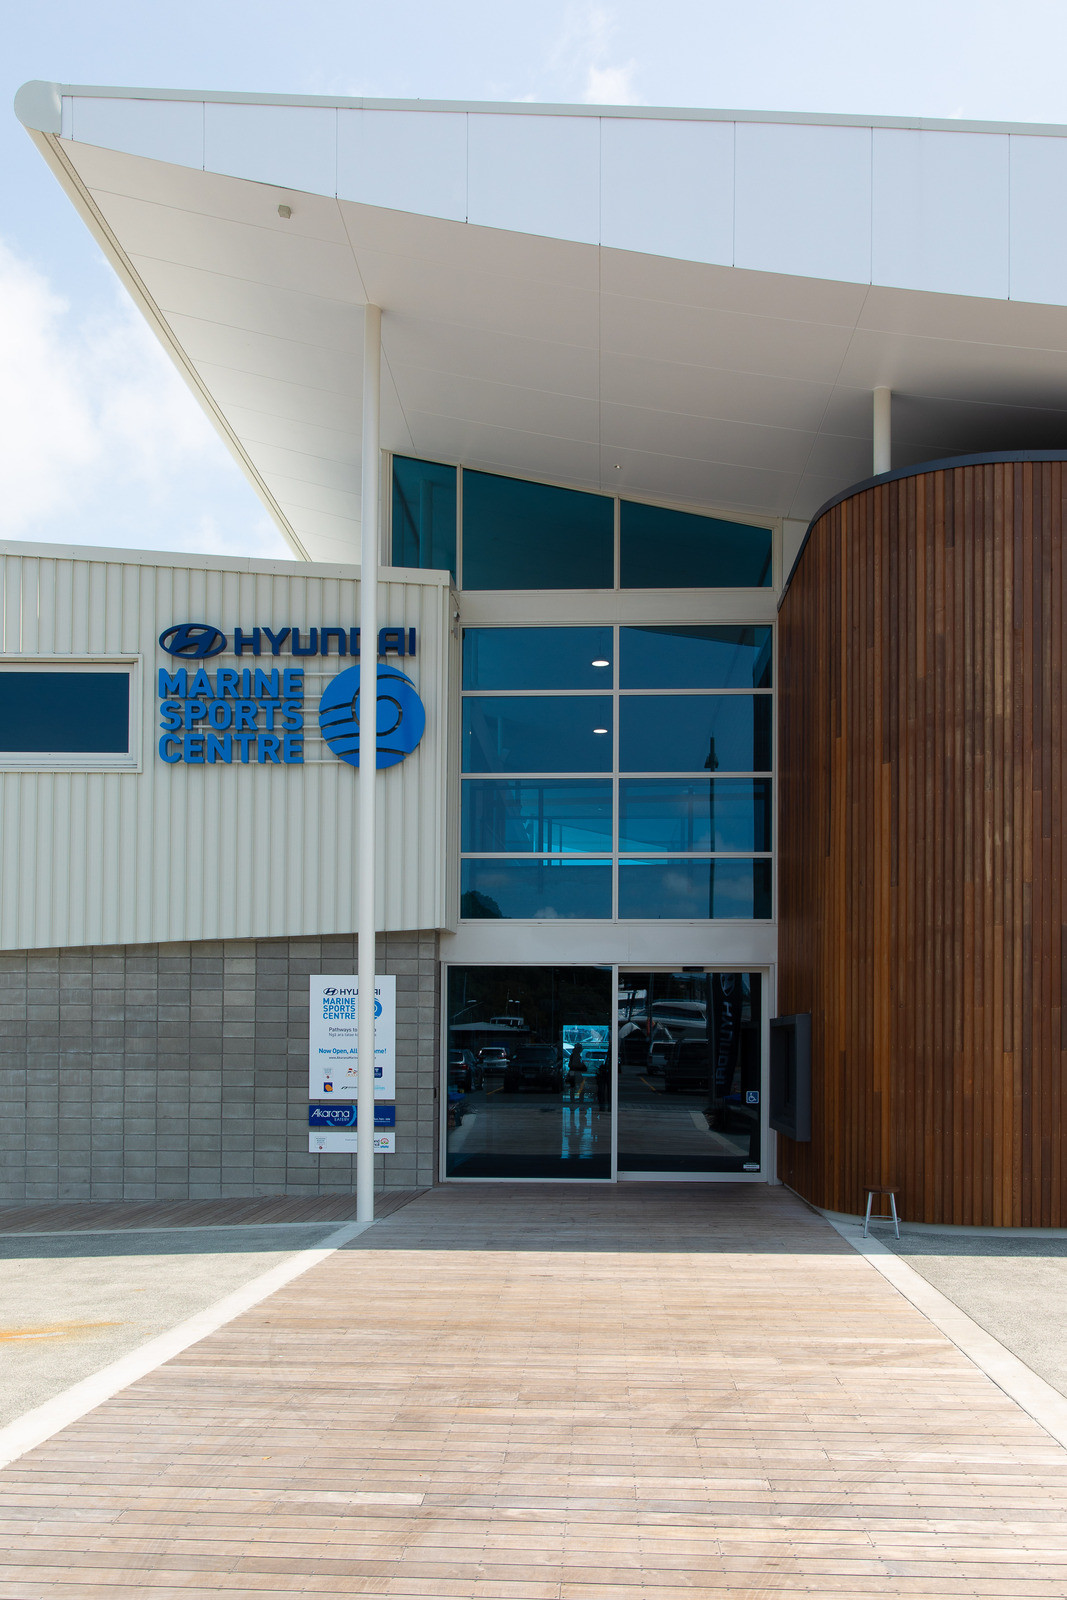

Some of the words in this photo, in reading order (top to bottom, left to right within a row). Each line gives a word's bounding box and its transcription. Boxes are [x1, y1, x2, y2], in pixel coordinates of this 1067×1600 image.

[158, 668, 304, 699] MARINE
[159, 701, 304, 731] SPORTS
[158, 733, 304, 764] CENTRE
[340, 988, 381, 996] HYUAI
[322, 1012, 356, 1020] CENTRE
[311, 1108, 350, 1118] Akarana
